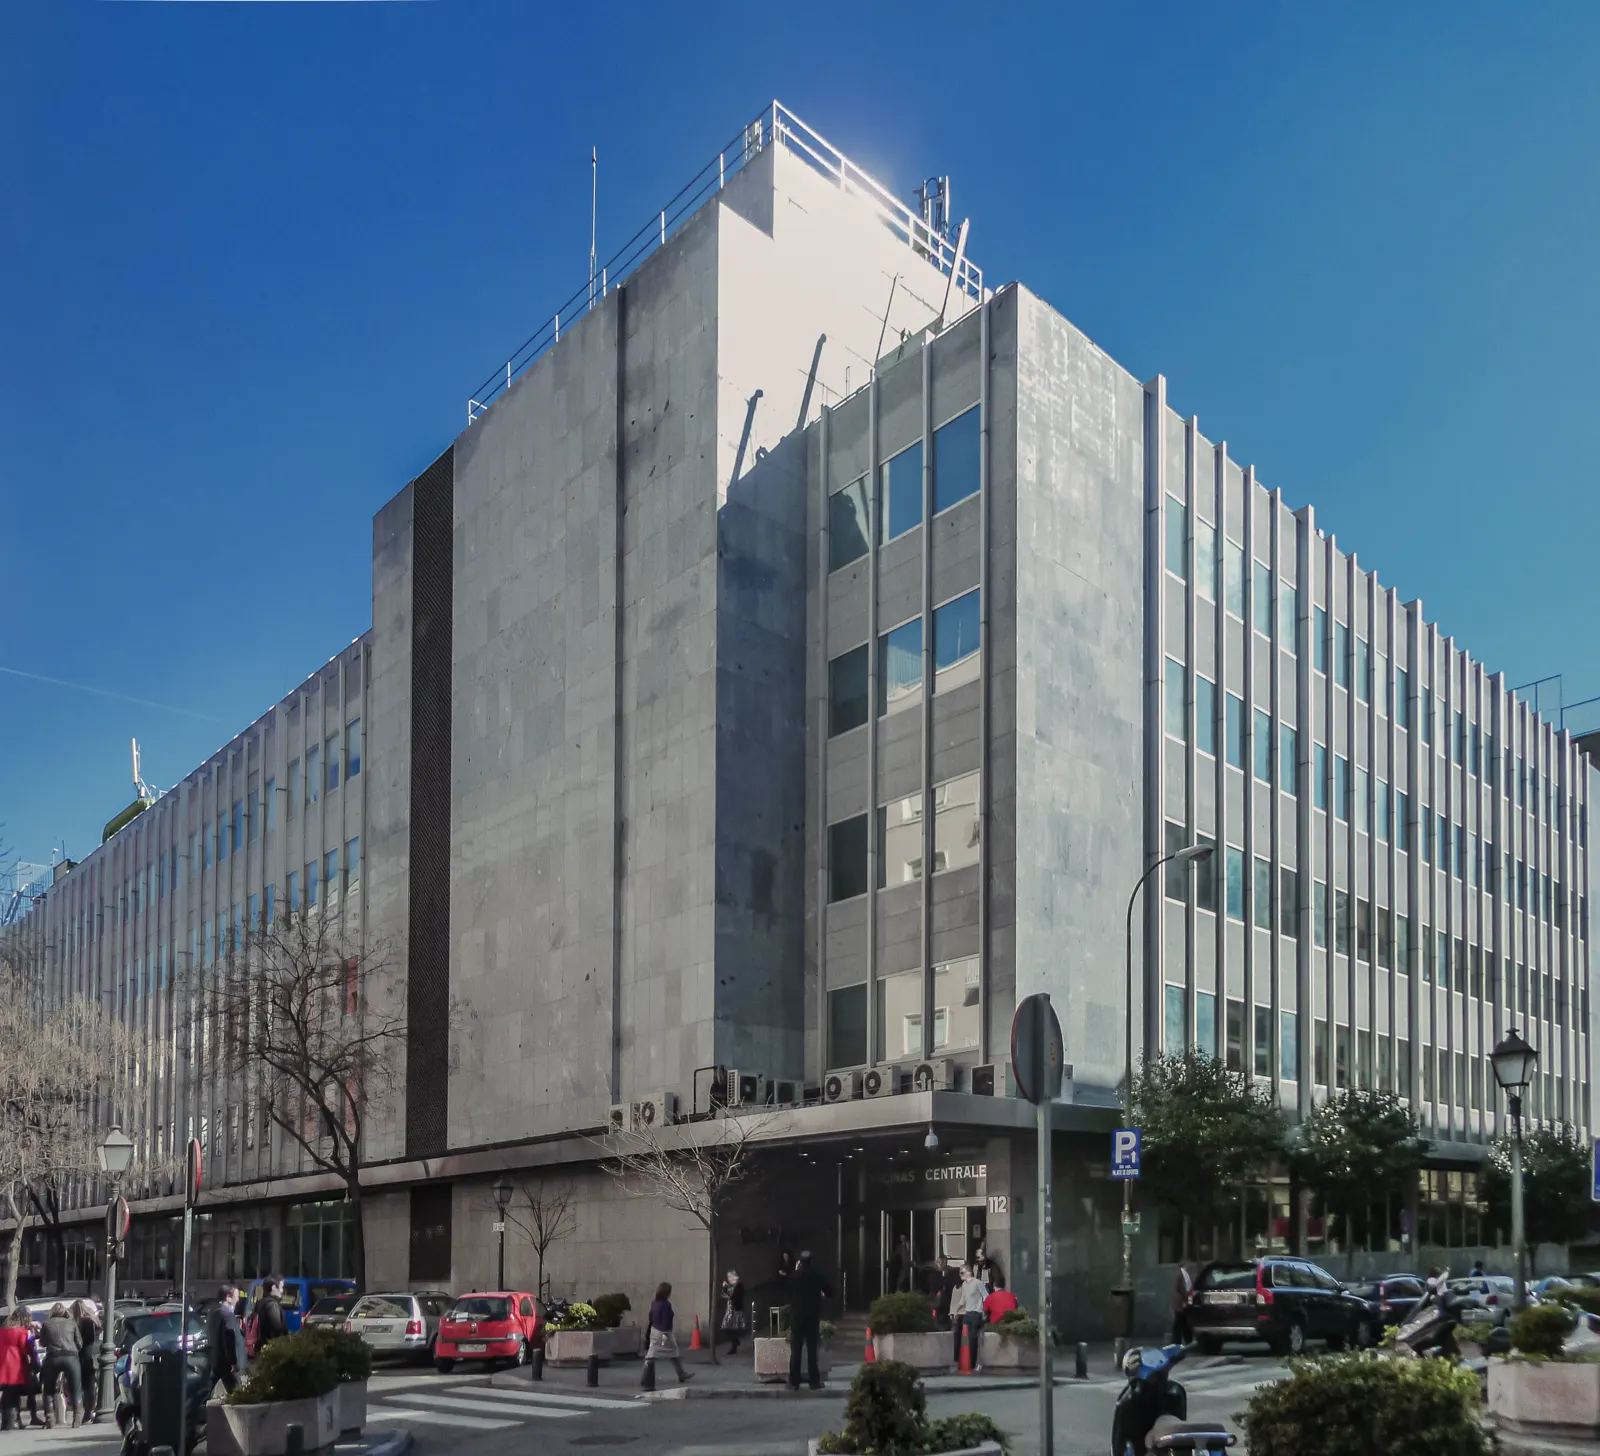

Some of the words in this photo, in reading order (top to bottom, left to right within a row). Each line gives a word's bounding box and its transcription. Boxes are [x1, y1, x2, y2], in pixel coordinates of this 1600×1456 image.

[1115, 1131, 1137, 1164] P
[925, 1164, 987, 1181] CENTRALE
[988, 1195, 1007, 1214] 112
